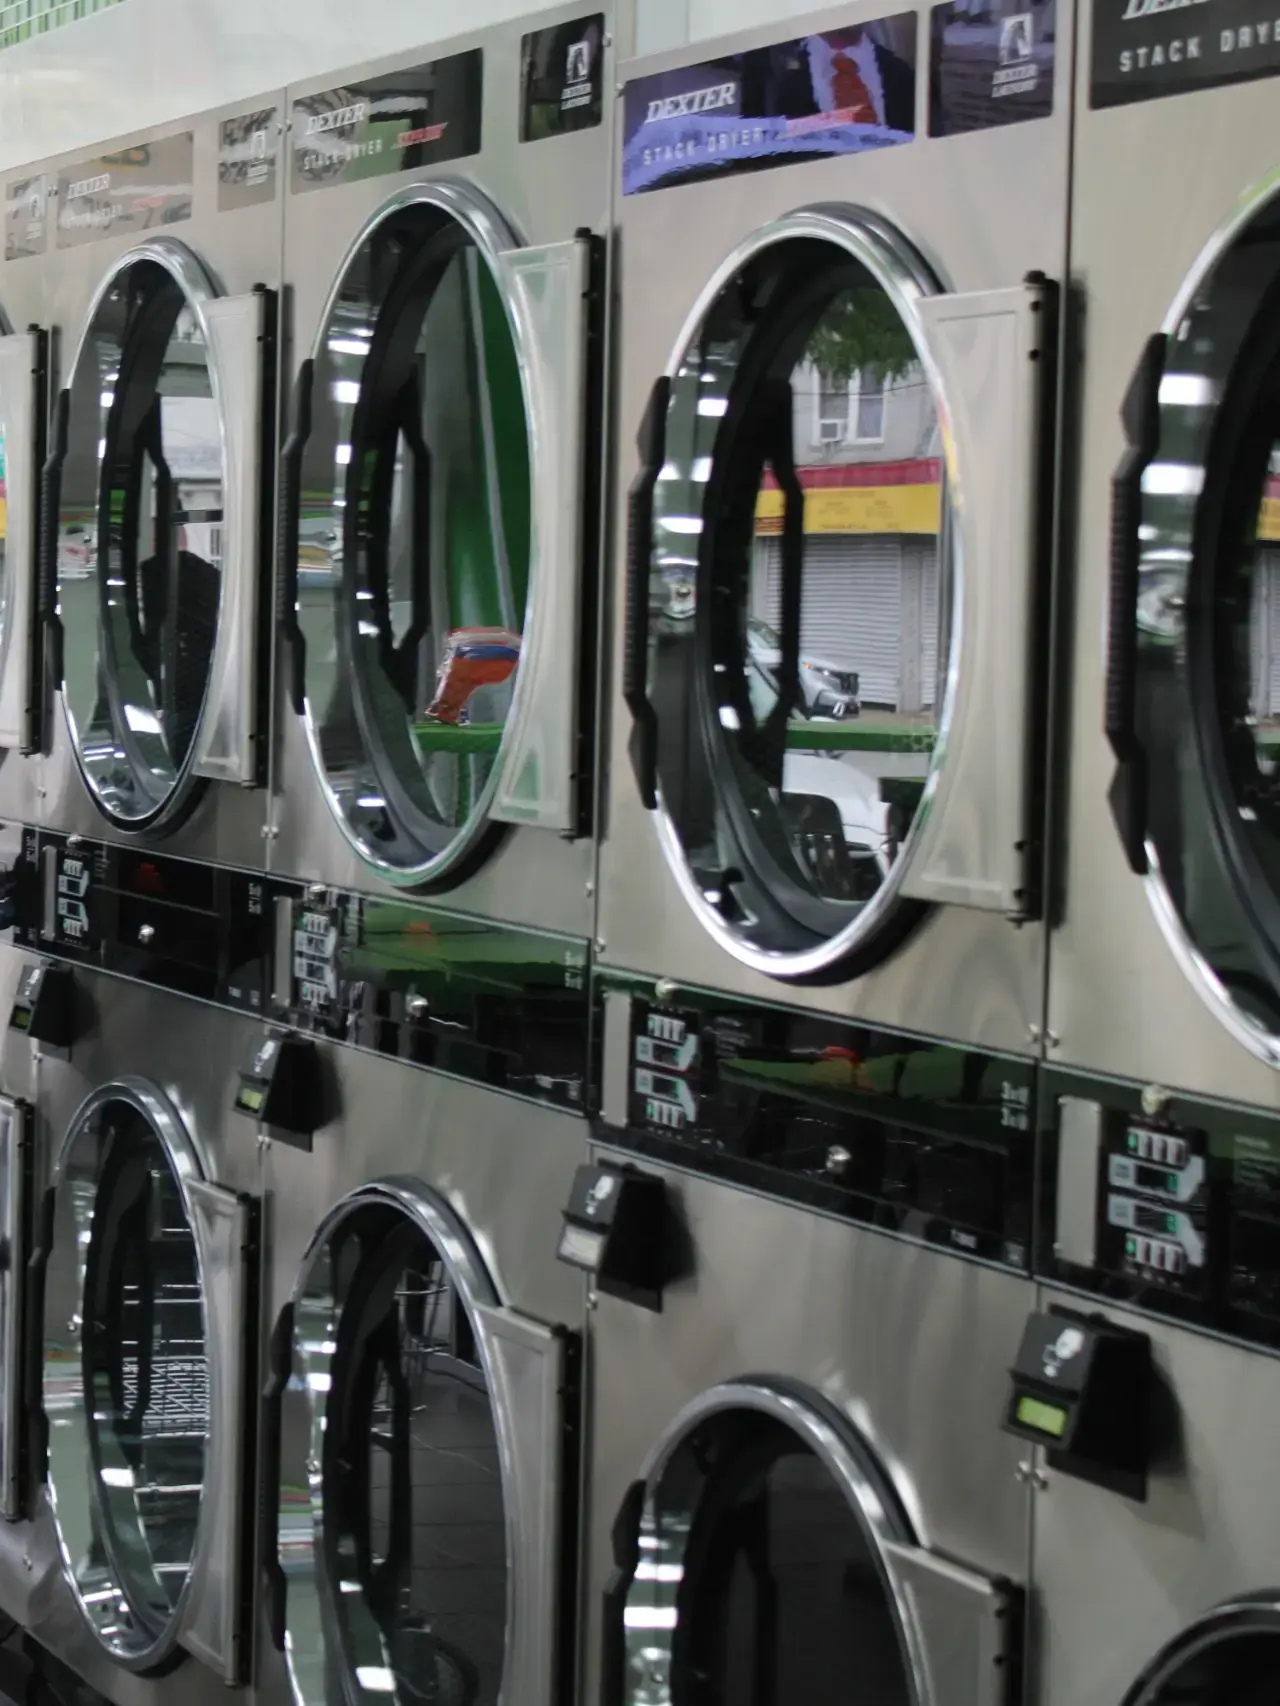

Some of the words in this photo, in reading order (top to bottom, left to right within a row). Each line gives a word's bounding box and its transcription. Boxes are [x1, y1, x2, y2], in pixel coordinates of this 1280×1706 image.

[1119, 36, 1201, 72] STACK
[306, 103, 365, 135] DEXTER
[644, 81, 737, 124] DEXTER
[643, 142, 695, 166] STACK
[709, 127, 762, 154] DRYER
